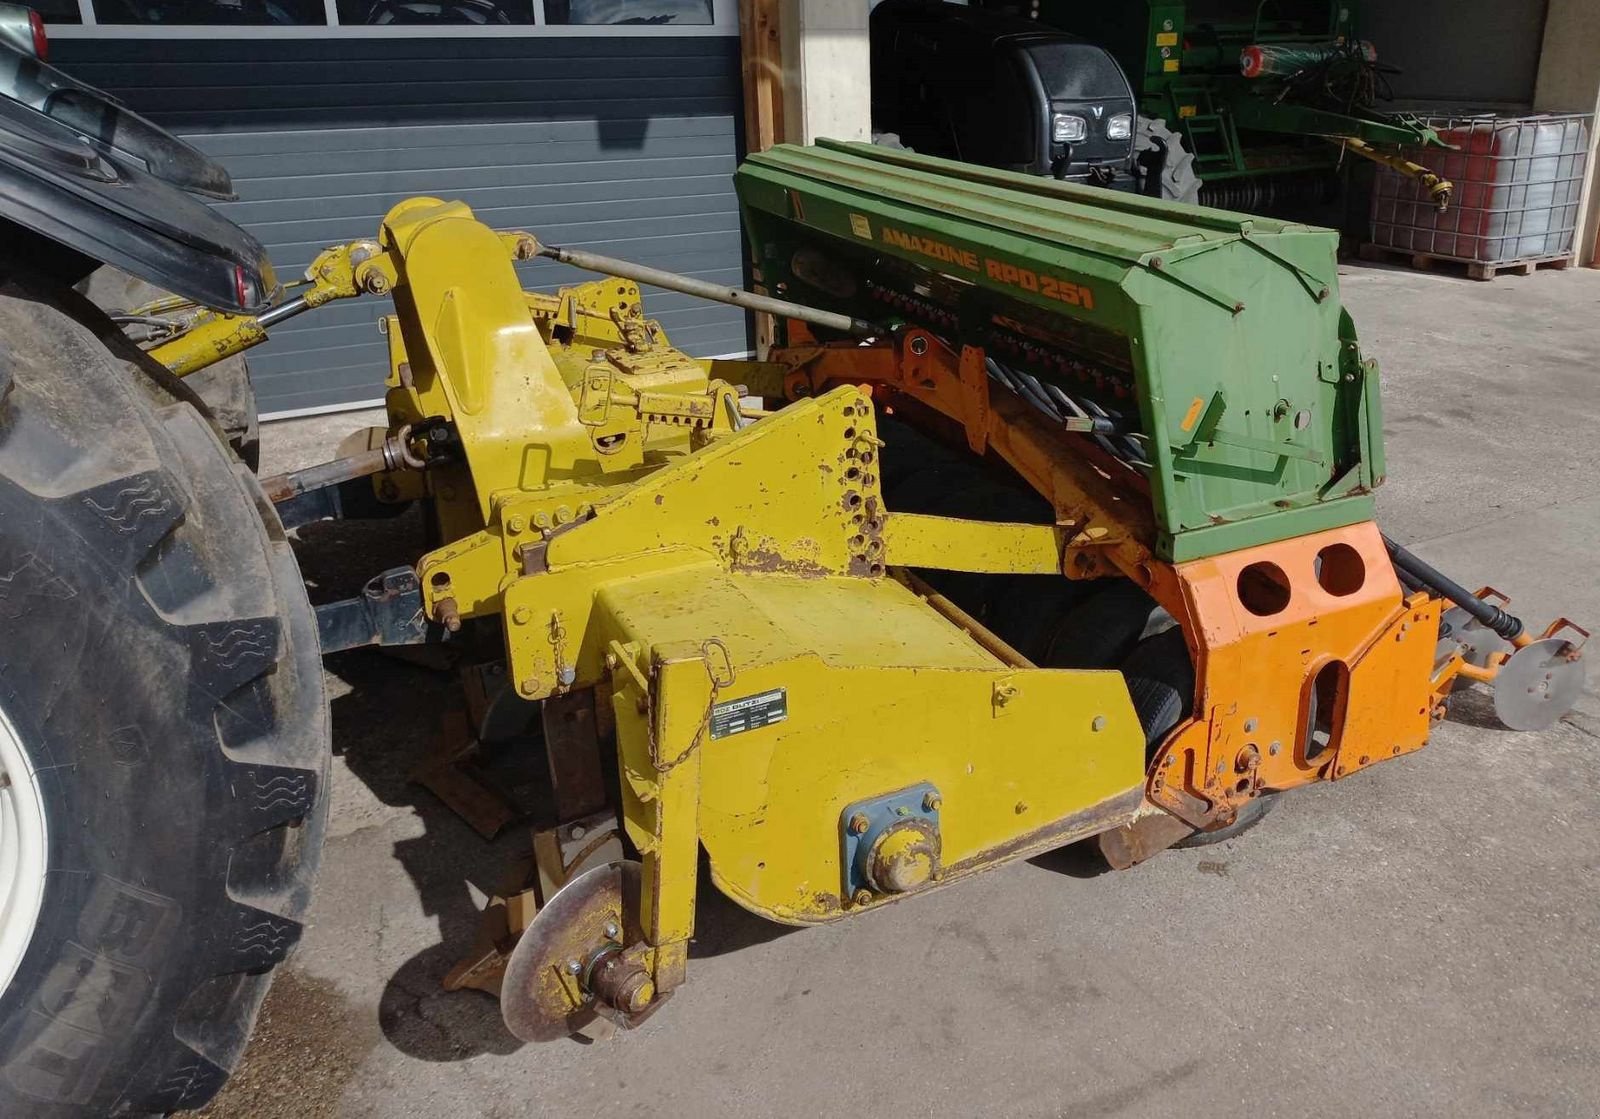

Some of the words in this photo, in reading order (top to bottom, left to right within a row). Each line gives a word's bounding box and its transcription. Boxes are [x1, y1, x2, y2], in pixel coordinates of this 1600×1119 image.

[882, 227, 980, 272] AMAZONE
[1039, 275, 1094, 310] 251
[1, 872, 183, 1105] BKT
